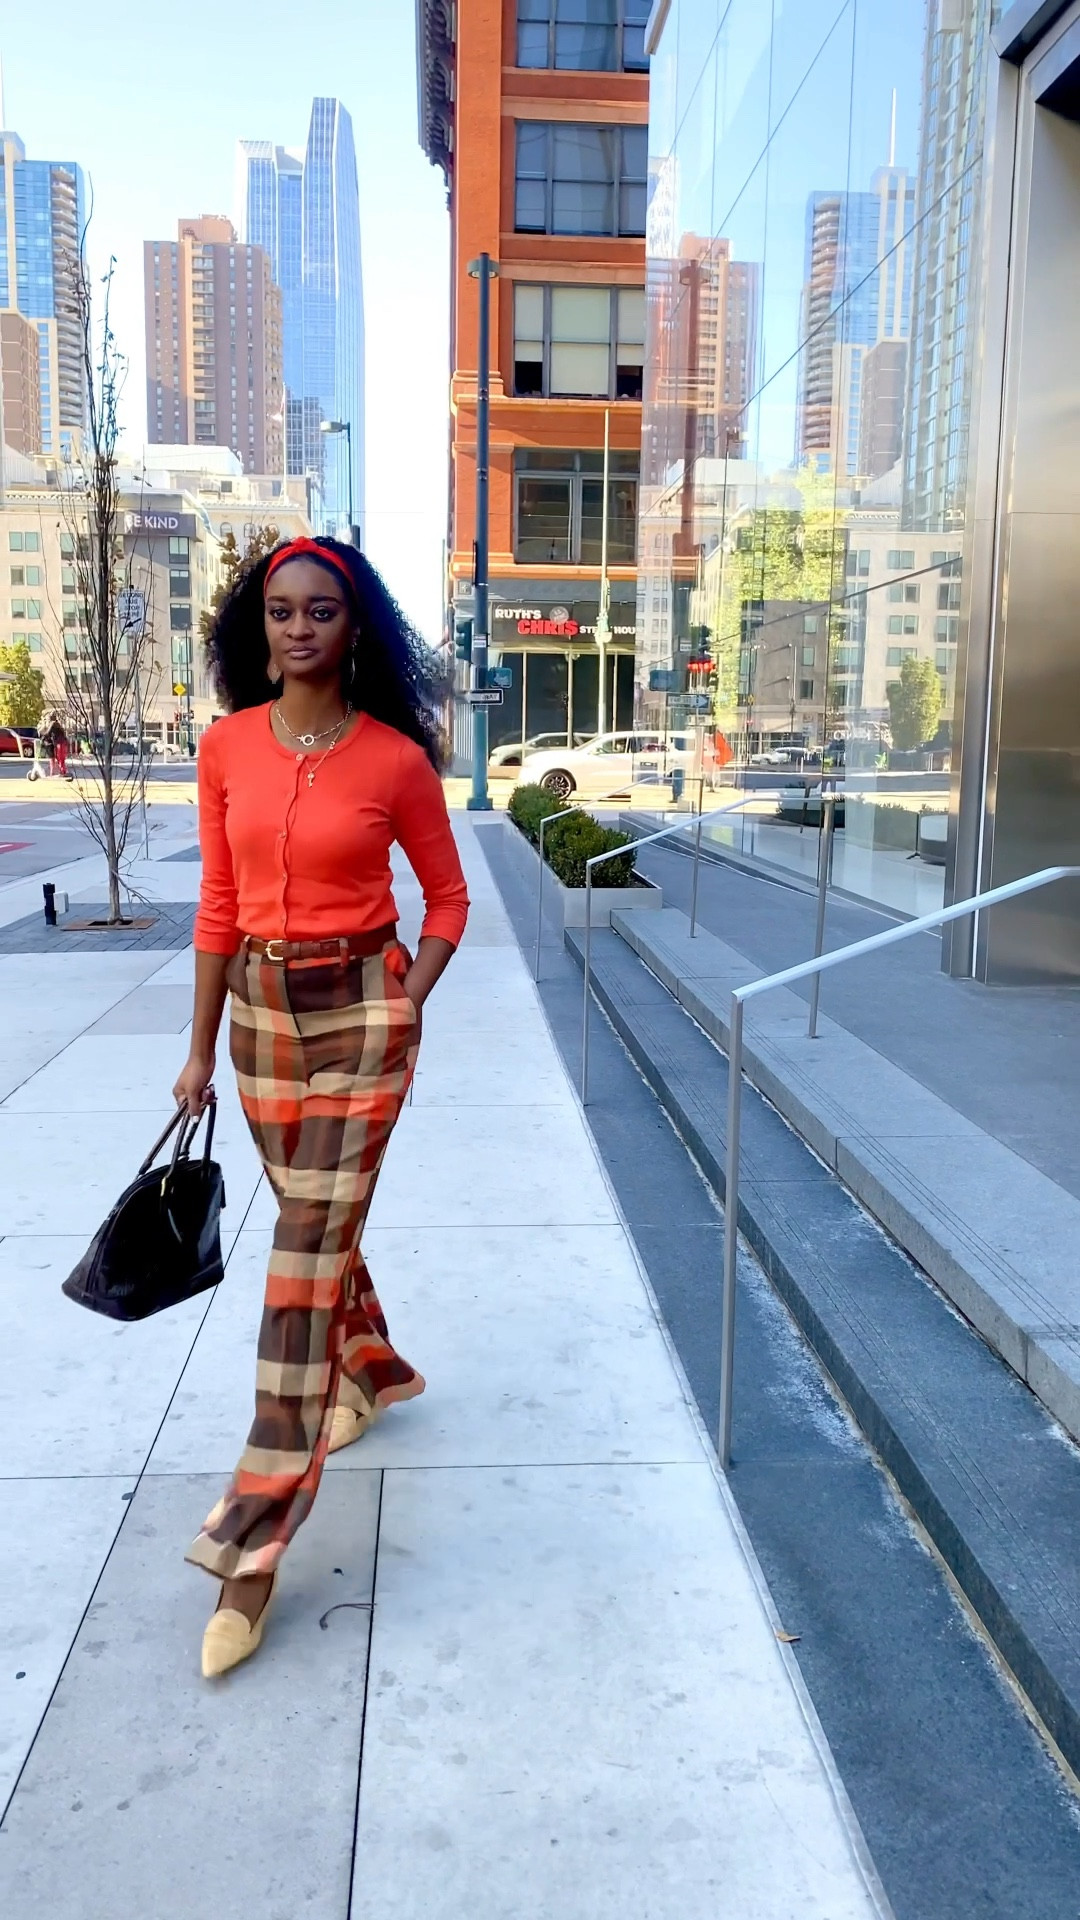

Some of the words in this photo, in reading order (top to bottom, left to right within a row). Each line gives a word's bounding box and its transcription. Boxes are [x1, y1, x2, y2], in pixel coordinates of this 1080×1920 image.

[144, 515, 178, 529] KIND
[494, 609, 542, 620] RUTH'S
[517, 619, 578, 636] CHRIS
[614, 626, 636, 634] HOU
